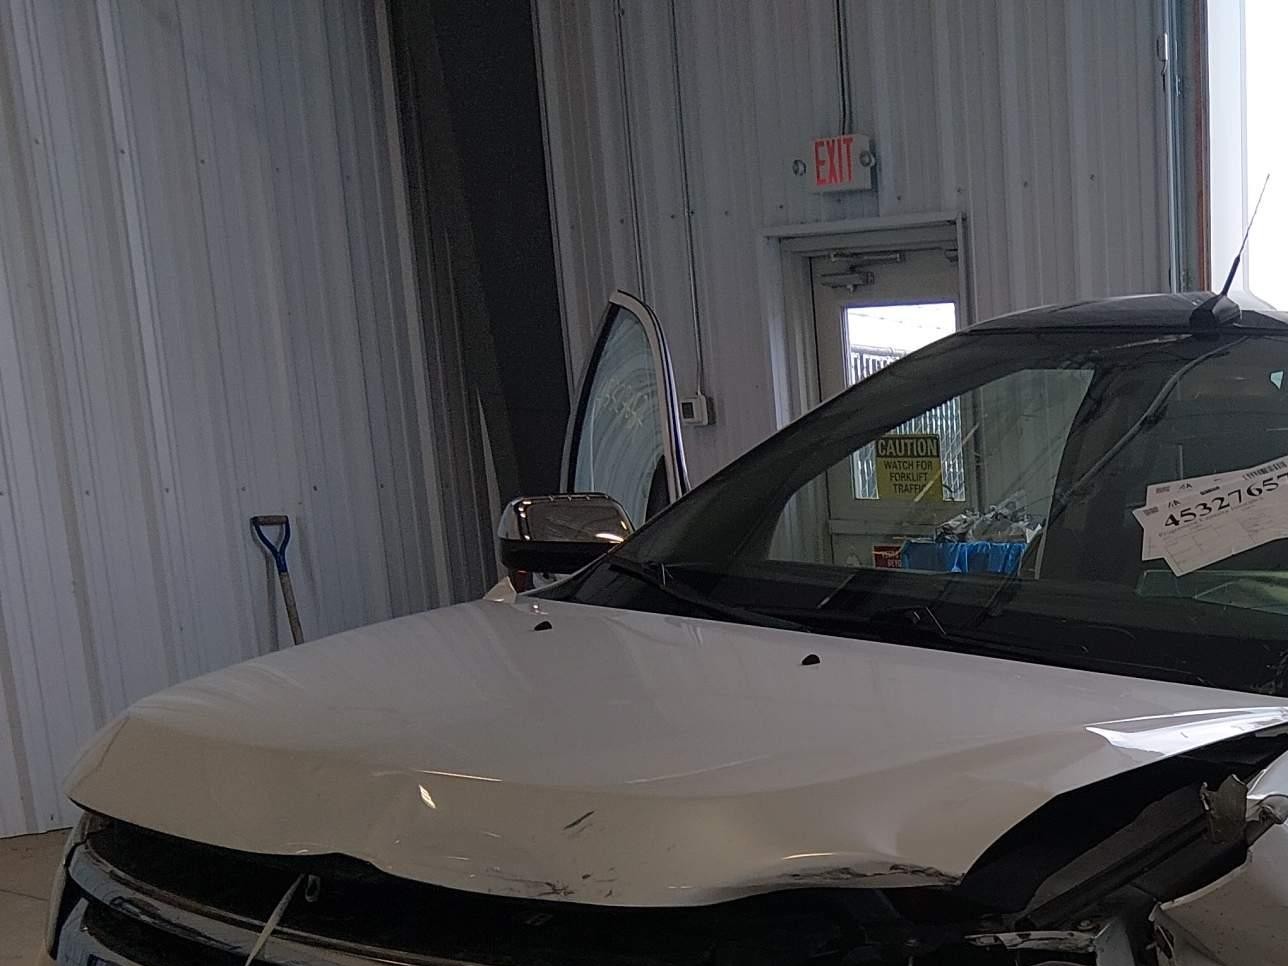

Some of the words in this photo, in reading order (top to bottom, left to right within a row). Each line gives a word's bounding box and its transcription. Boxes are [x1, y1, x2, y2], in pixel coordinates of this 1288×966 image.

[814, 137, 853, 186] EXIT
[877, 439, 938, 456] CAUTION
[884, 460, 914, 471] WATCH
[916, 460, 933, 471] FOR
[889, 472, 928, 482] FORKLIFT
